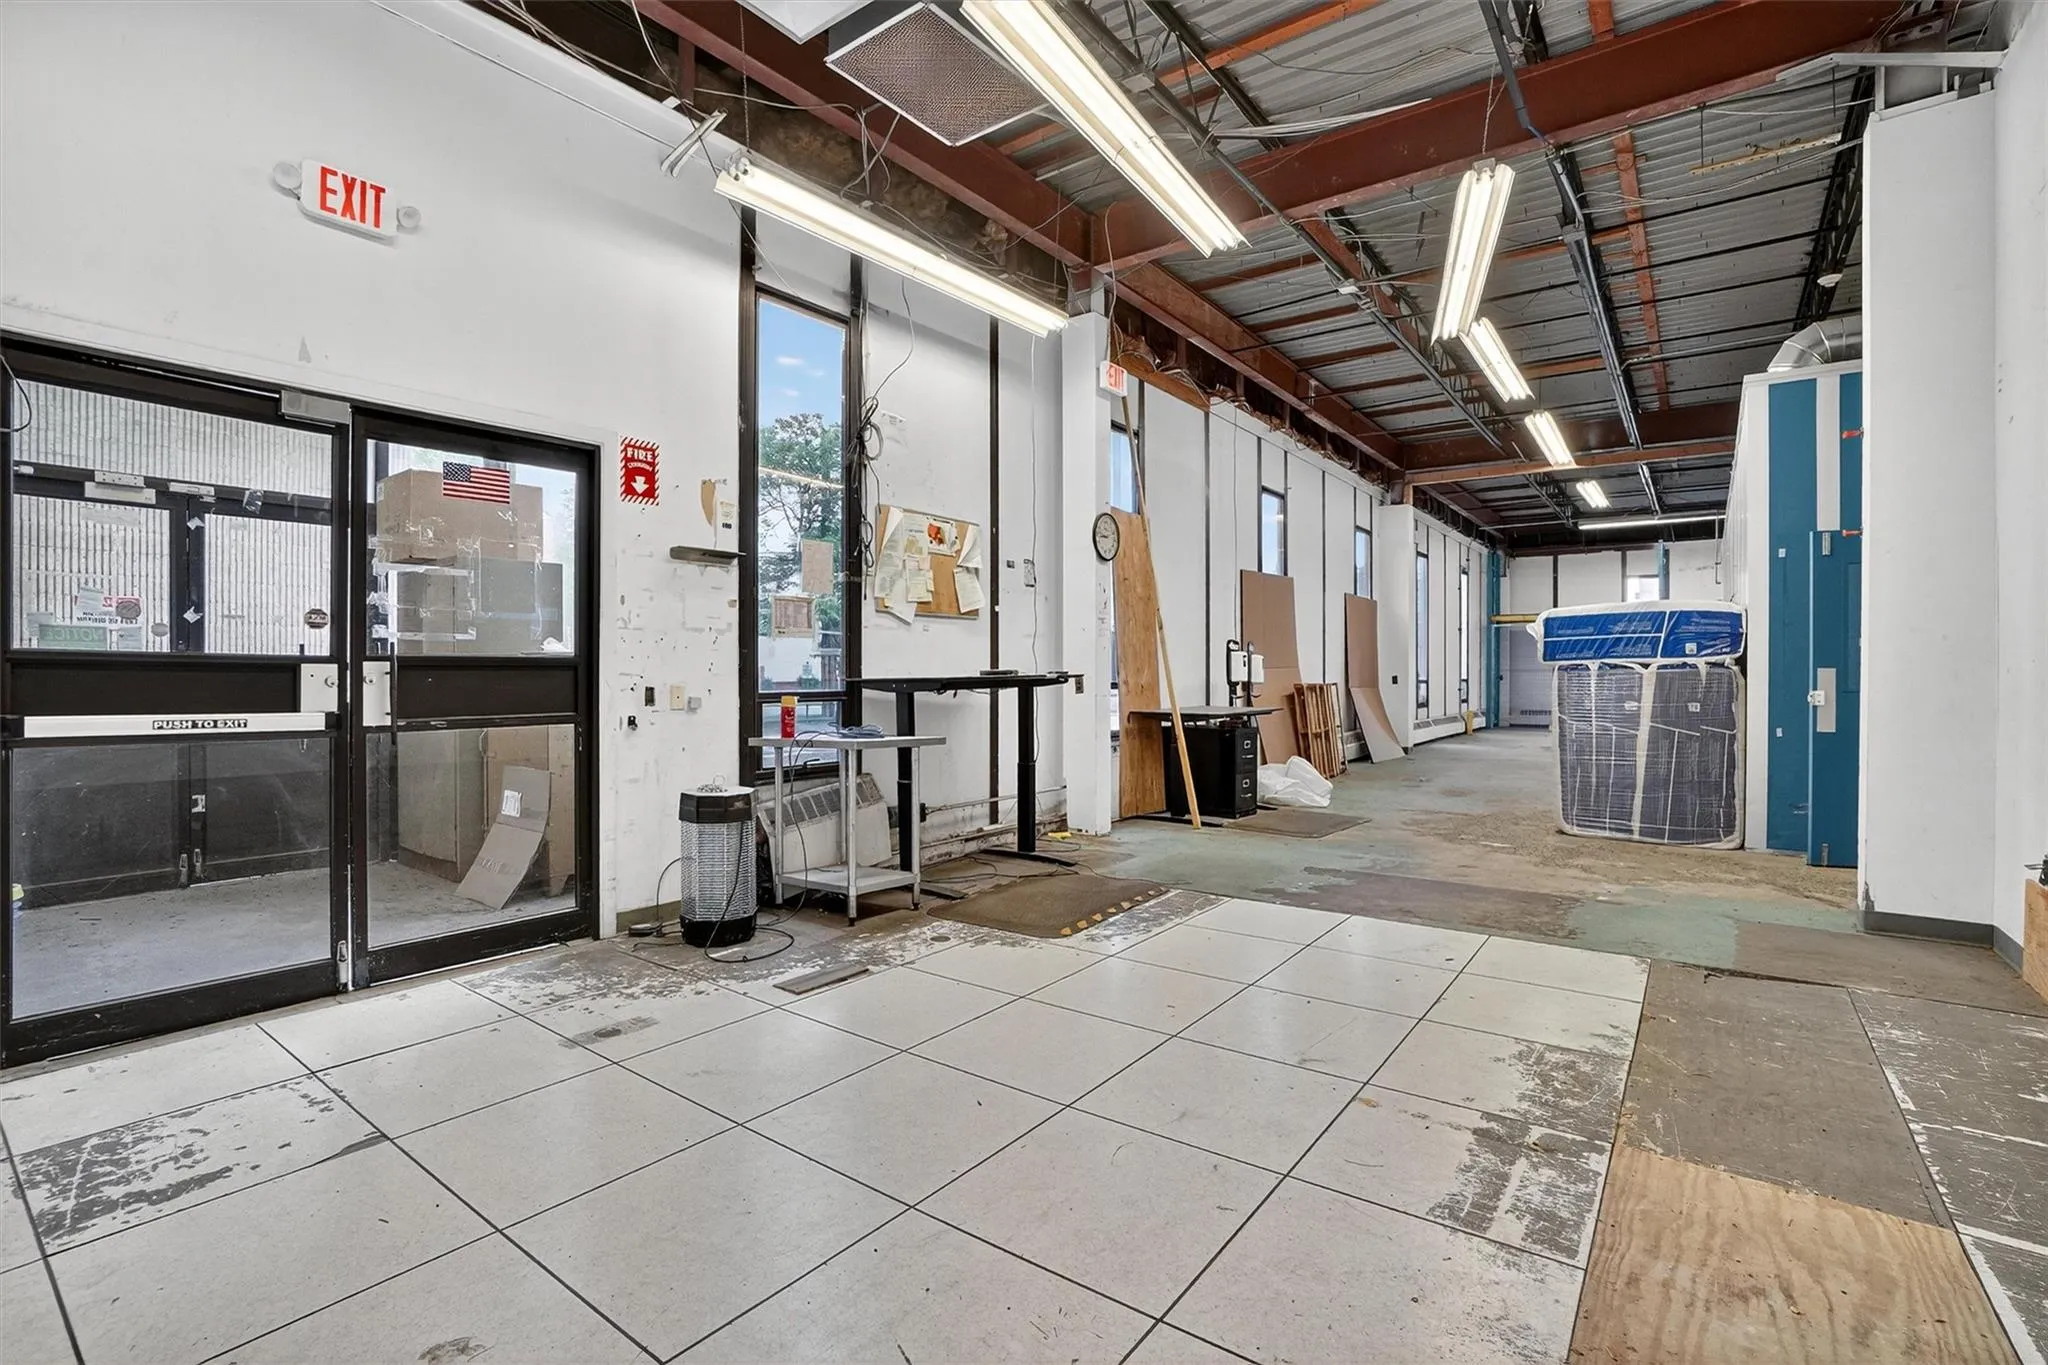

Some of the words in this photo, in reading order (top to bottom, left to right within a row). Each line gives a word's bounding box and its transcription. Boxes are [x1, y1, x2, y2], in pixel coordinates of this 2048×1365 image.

[320, 165, 386, 229] EXIT
[1107, 363, 1125, 391] EXIT
[626, 447, 654, 461] FIRE
[153, 720, 192, 730] PUSH
[195, 720, 214, 729] TO
[217, 719, 247, 729] EXIT
